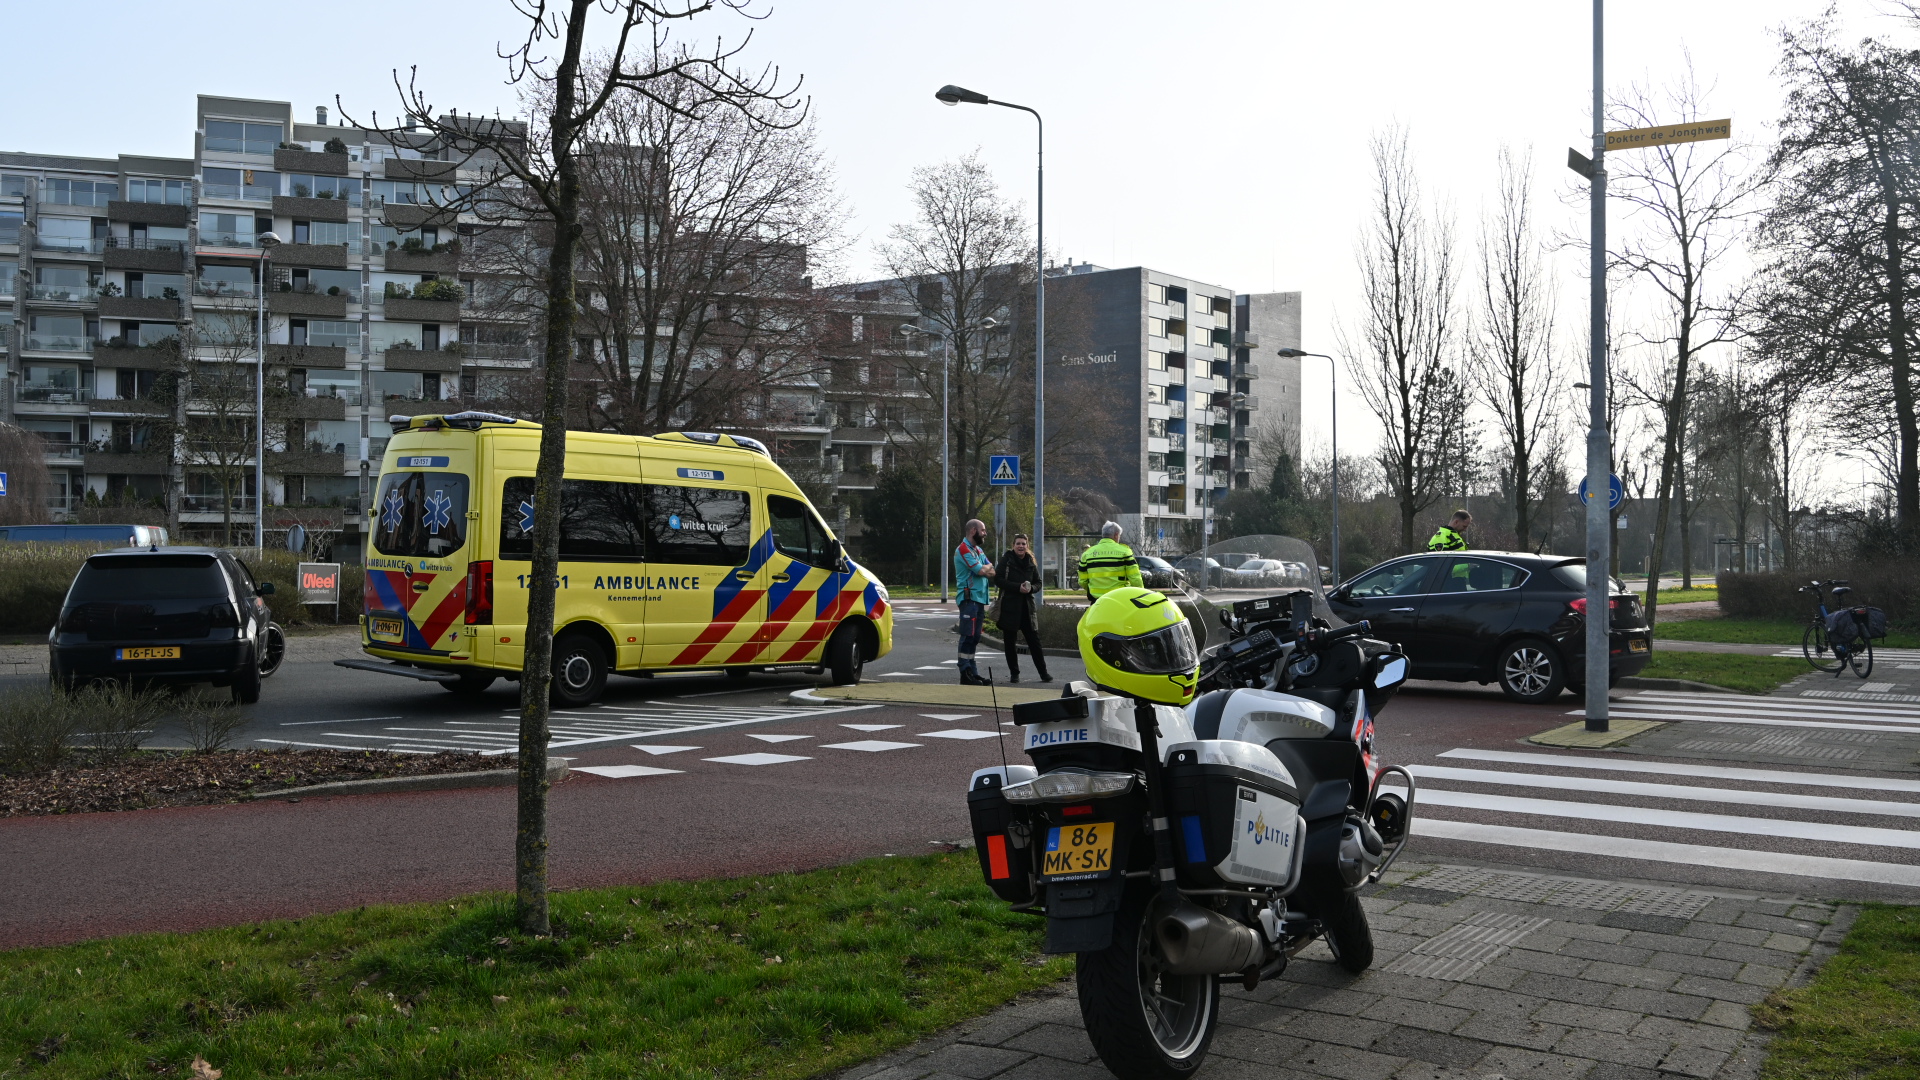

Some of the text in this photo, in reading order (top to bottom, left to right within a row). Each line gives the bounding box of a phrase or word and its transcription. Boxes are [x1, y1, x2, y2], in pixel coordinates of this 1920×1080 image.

[1608, 125, 1727, 145] Dokter de Jonghweg
[1061, 350, 1117, 366] Sans Souci
[691, 470, 711, 478] 12-151
[682, 520, 728, 532] witte kruis
[368, 558, 406, 569] AMBULANCE
[440, 564, 453, 572] kruis
[593, 576, 700, 590] AMBULANCE
[128, 648, 174, 659] 16-FL-JS
[1031, 728, 1088, 746] POLITIE
[1071, 826, 1098, 847] 86
[1045, 848, 1108, 873] MK-SK
[1051, 873, 1099, 882] bmw-motorrad.nl
